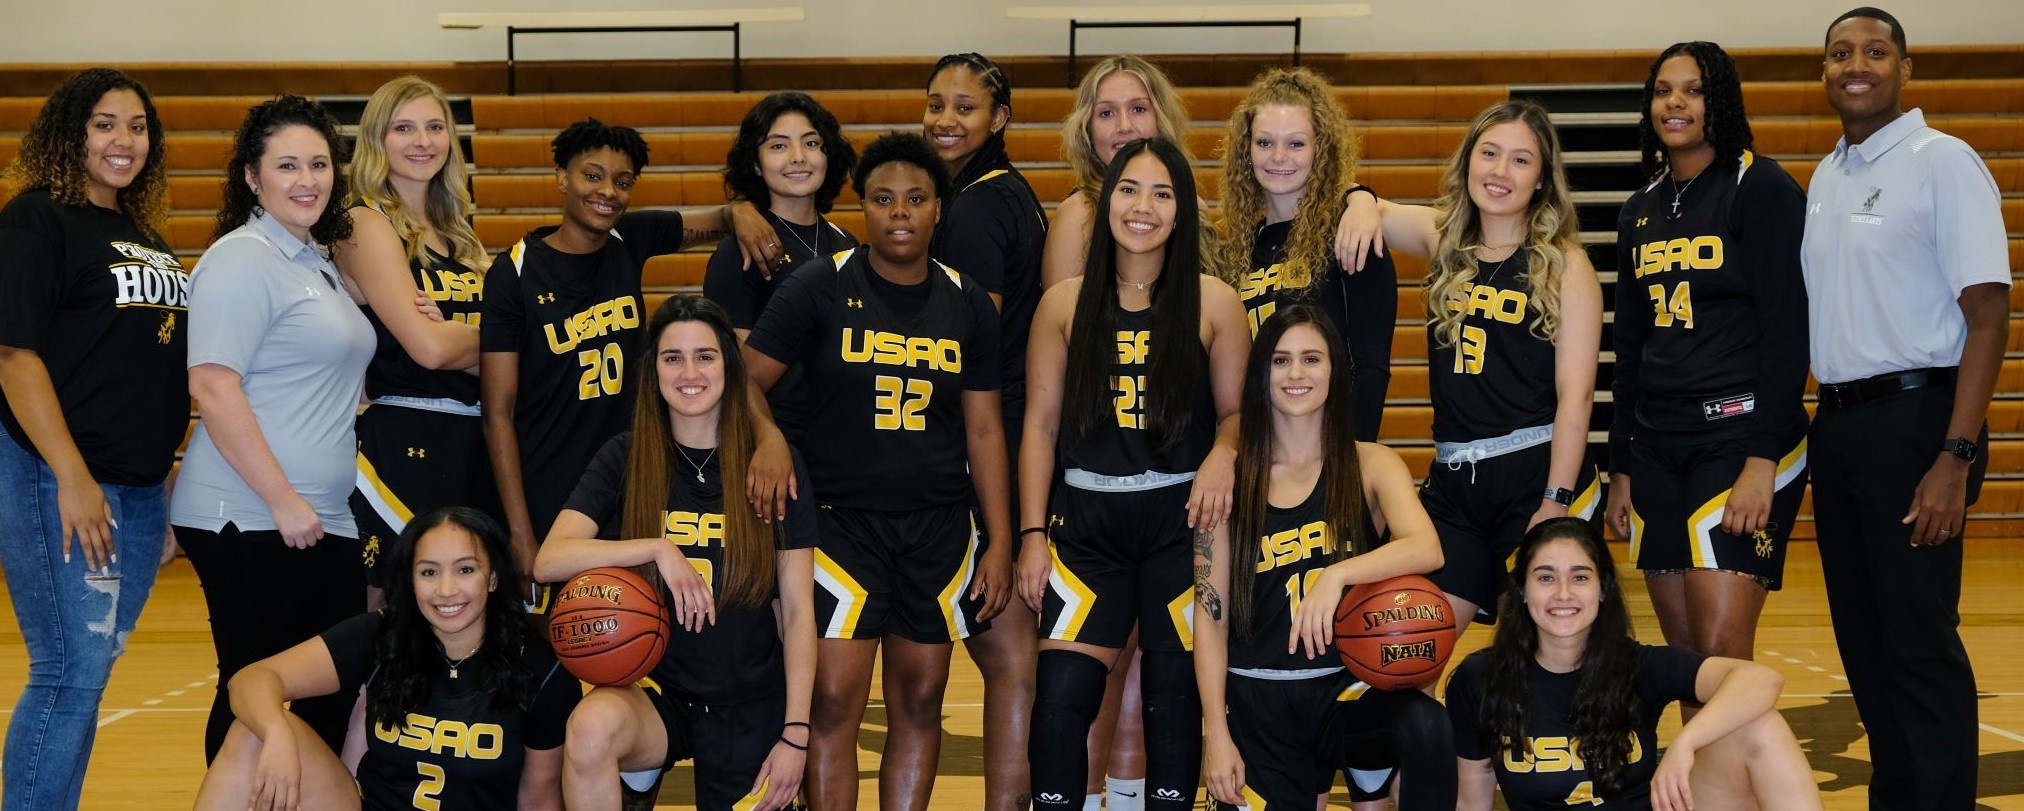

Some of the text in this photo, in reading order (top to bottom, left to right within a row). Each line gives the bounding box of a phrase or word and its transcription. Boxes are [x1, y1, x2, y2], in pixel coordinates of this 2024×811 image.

[1632, 235, 1724, 279] USAO
[543, 295, 640, 355] USAO
[1451, 322, 1487, 375] 13
[578, 342, 624, 401] 20
[841, 327, 962, 374] USAO
[874, 374, 934, 431] 32
[661, 510, 727, 548] SA
[1255, 520, 1352, 573] USA
[1362, 604, 1445, 632] SPALDING
[1382, 640, 1435, 666] NAIA
[374, 713, 504, 760] USAO
[412, 761, 446, 811] 2
[1564, 781, 1605, 807] 4
